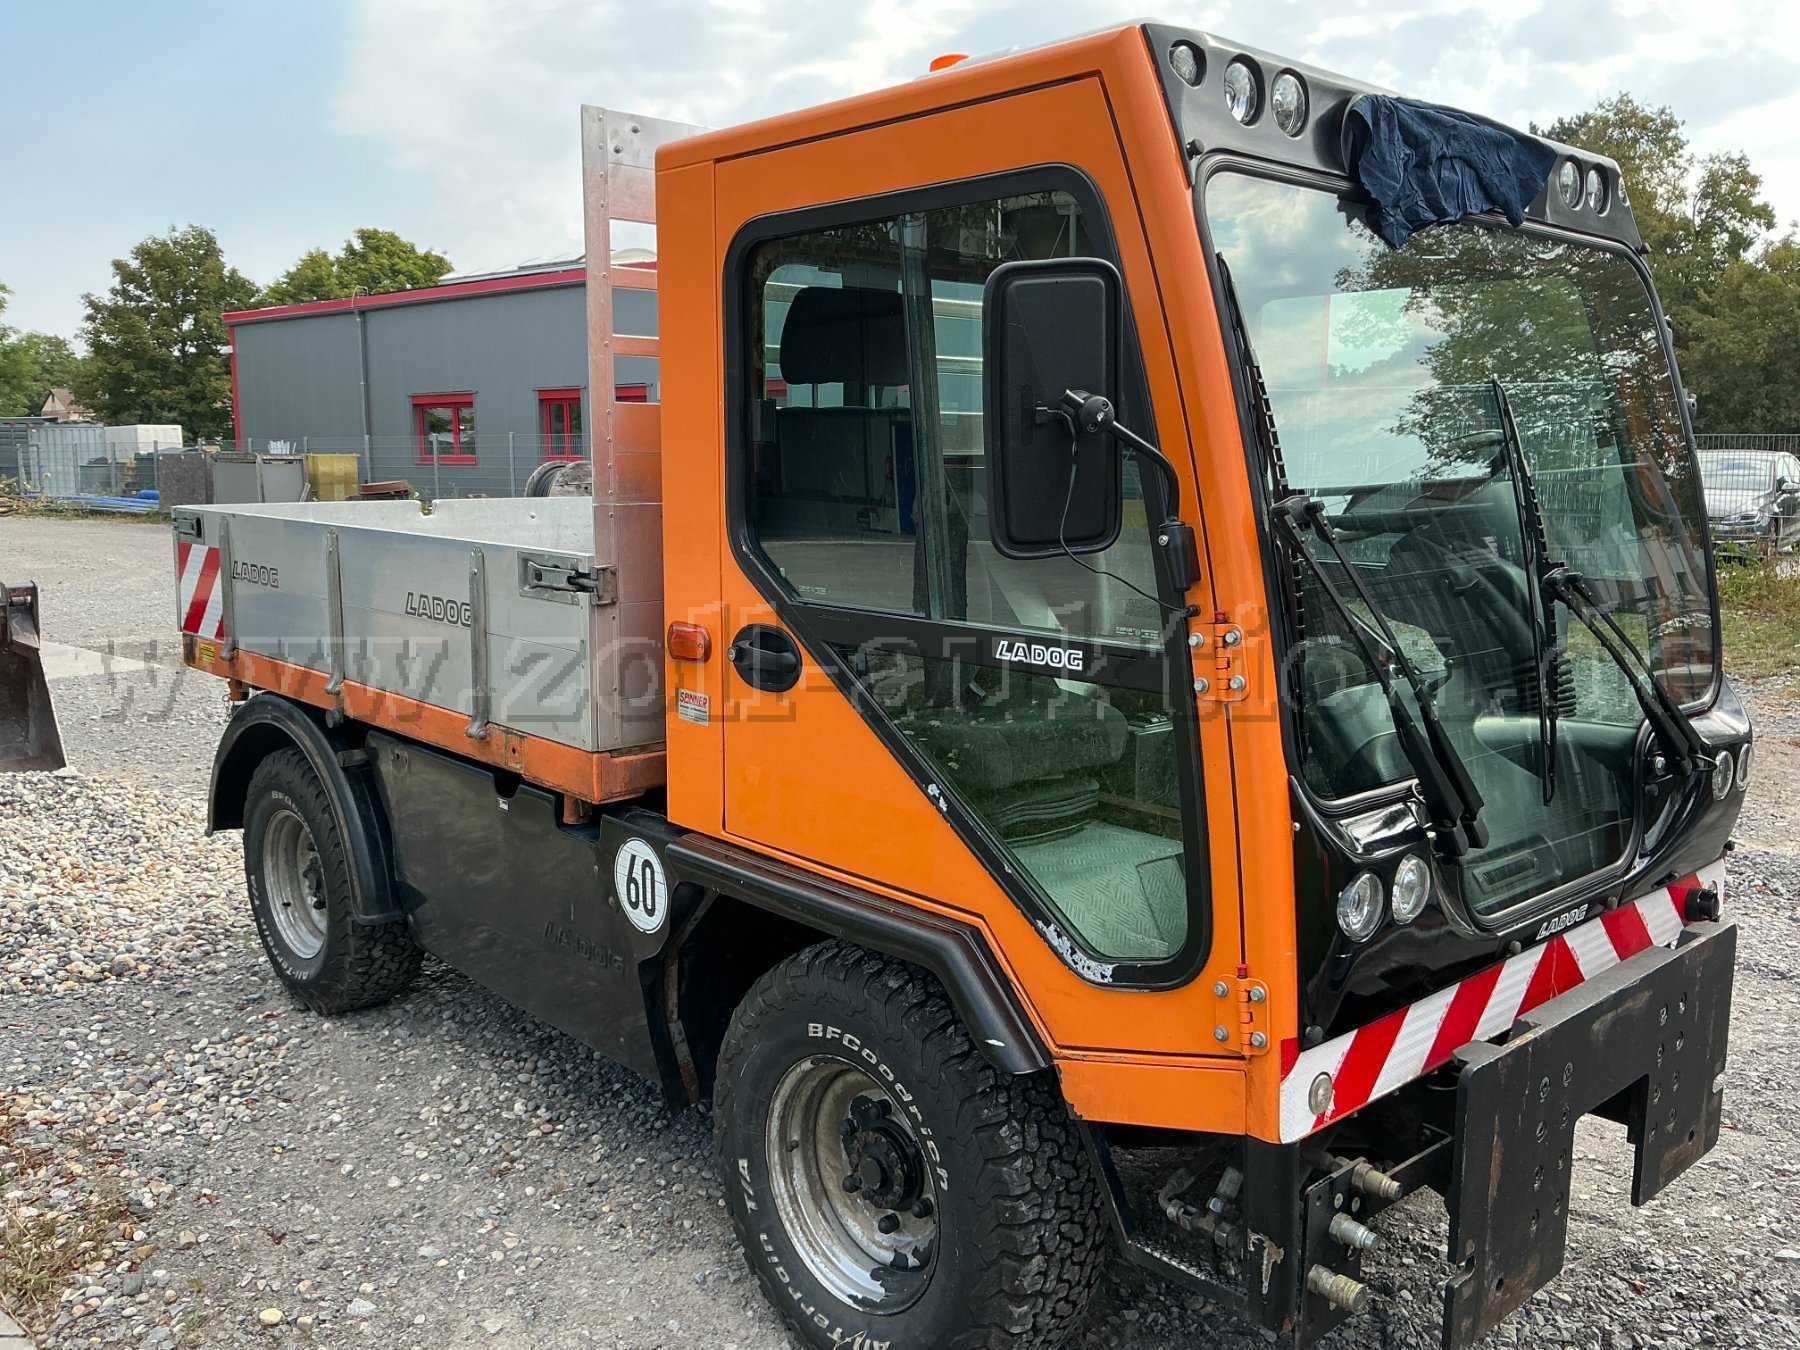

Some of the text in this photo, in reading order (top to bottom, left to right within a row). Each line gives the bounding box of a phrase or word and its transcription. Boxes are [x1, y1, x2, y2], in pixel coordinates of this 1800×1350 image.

[231, 560, 279, 588] LADOG
[405, 592, 471, 628] LADOG
[995, 640, 1083, 671] LADOG
[626, 854, 656, 918] 60
[1535, 903, 1589, 941] LADOG
[807, 1022, 949, 1192] BFGoodrich
